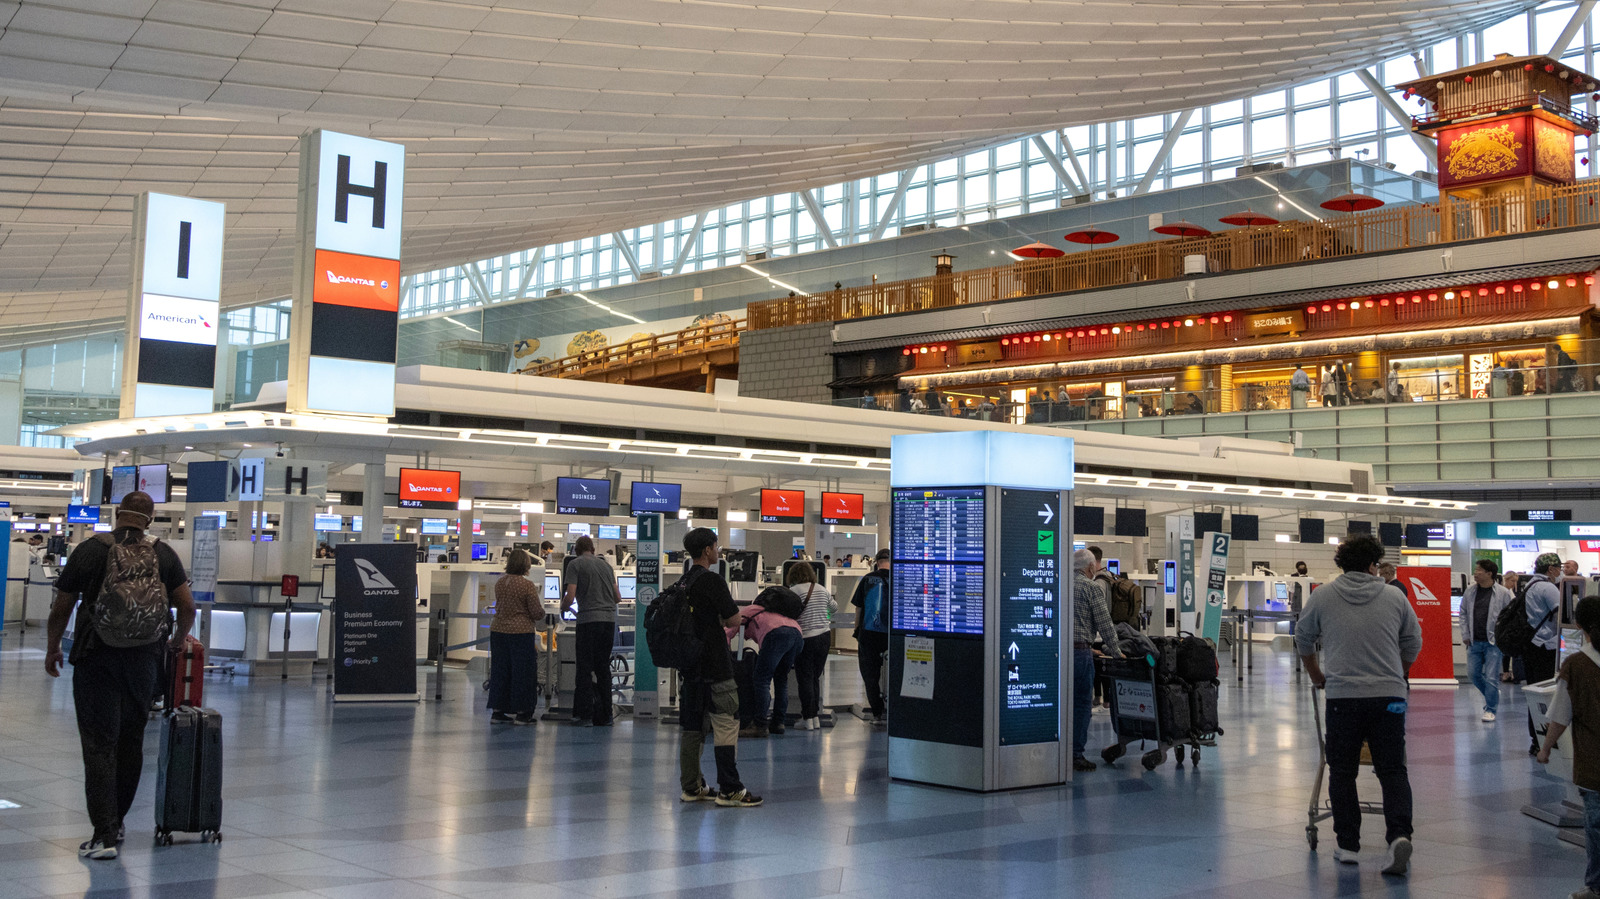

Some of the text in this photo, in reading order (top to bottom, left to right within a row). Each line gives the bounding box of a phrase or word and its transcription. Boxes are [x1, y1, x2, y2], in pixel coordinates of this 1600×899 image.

[334, 154, 388, 229] H
[177, 221, 192, 279] I
[337, 275, 375, 287] QANTAS
[147, 312, 196, 325] American
[1253, 316, 1293, 328] おこのみ横丁
[241, 465, 257, 494] H
[285, 466, 308, 495] H
[416, 485, 443, 493] QANTAS
[643, 518, 652, 537] 1
[1215, 536, 1226, 553] 2
[1037, 559, 1054, 568] 出発
[1022, 568, 1054, 578] Departures
[343, 611, 373, 619] Business
[343, 619, 403, 628] Premium Economy
